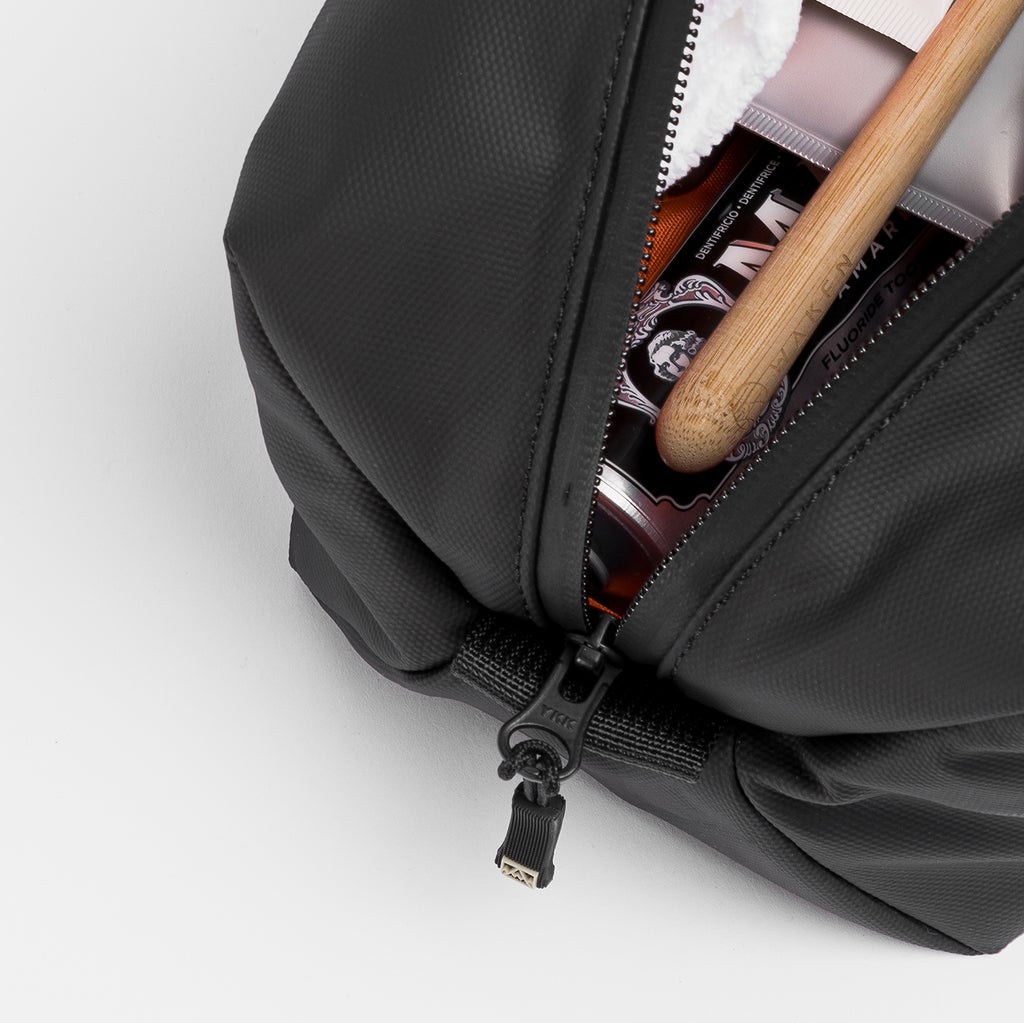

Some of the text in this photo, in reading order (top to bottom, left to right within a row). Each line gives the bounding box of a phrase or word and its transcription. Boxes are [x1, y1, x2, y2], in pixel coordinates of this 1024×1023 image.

[695, 210, 739, 260] DENTIFRICIO
[738, 159, 780, 205] DENTIFRICE
[821, 291, 885, 370] FLUORIDE
